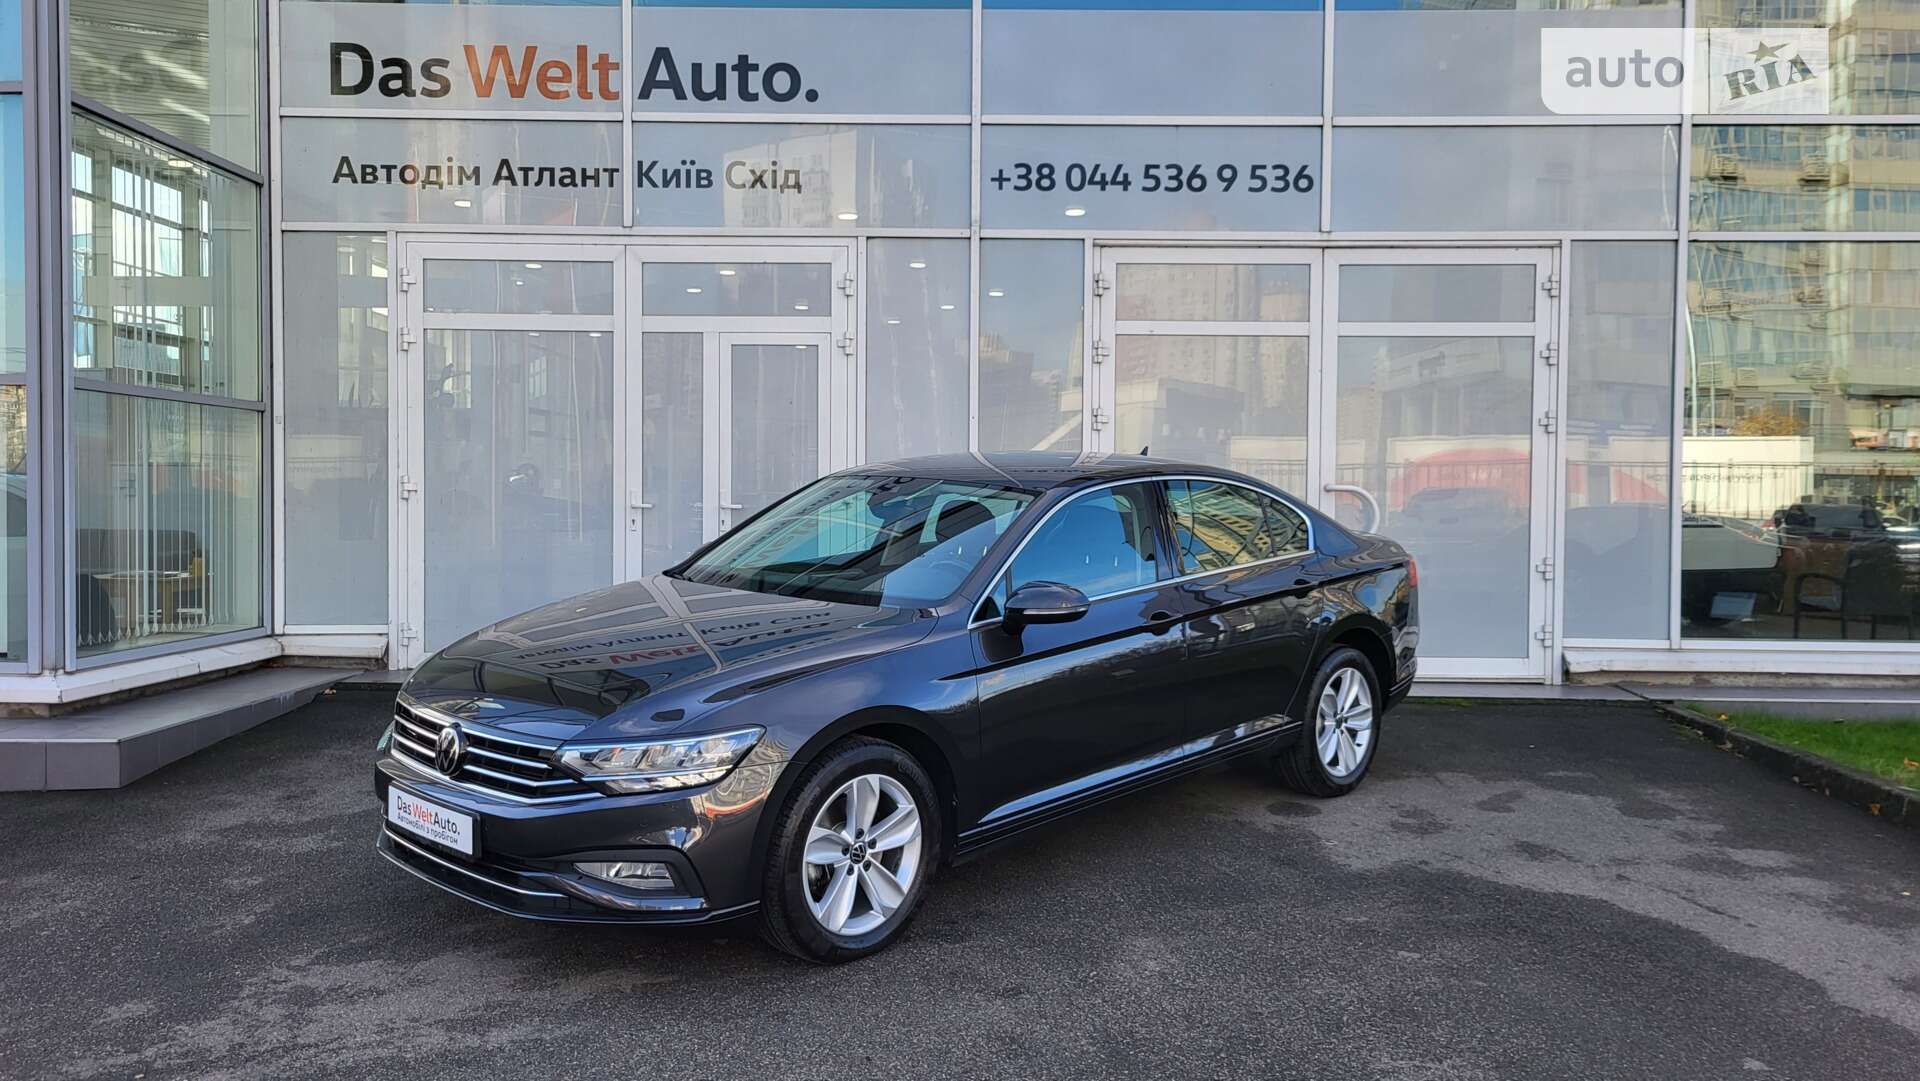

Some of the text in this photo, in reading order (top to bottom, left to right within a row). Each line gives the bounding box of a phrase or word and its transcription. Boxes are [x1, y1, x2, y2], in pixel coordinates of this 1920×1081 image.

[330, 42, 819, 102] Das Welt Auto.
[332, 156, 802, 193] Автодім Атлант Київ Схід
[990, 163, 1314, 193] +38 044 536 9 536
[397, 796, 461, 835] Das Welt Auto.
[431, 830, 459, 845] пробігом
